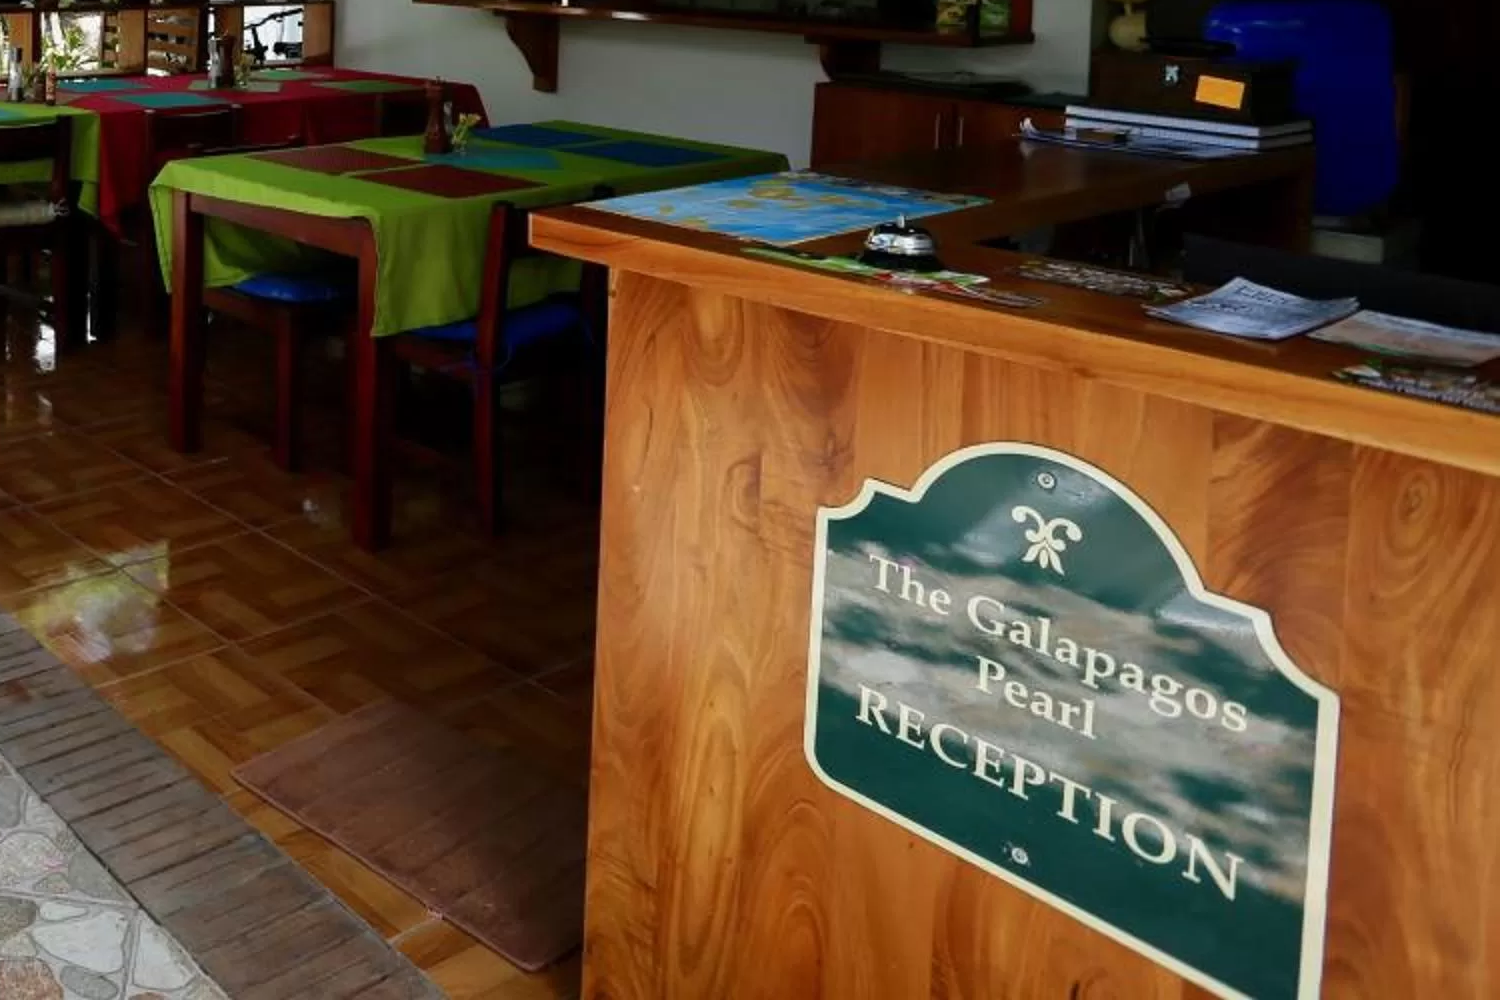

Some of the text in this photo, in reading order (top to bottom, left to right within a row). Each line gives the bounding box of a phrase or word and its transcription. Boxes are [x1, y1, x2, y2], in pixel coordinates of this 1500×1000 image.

[869, 555, 1248, 732] The Galapagos
[974, 655, 1097, 740] Pearl
[855, 682, 1245, 901] RECEPTION
